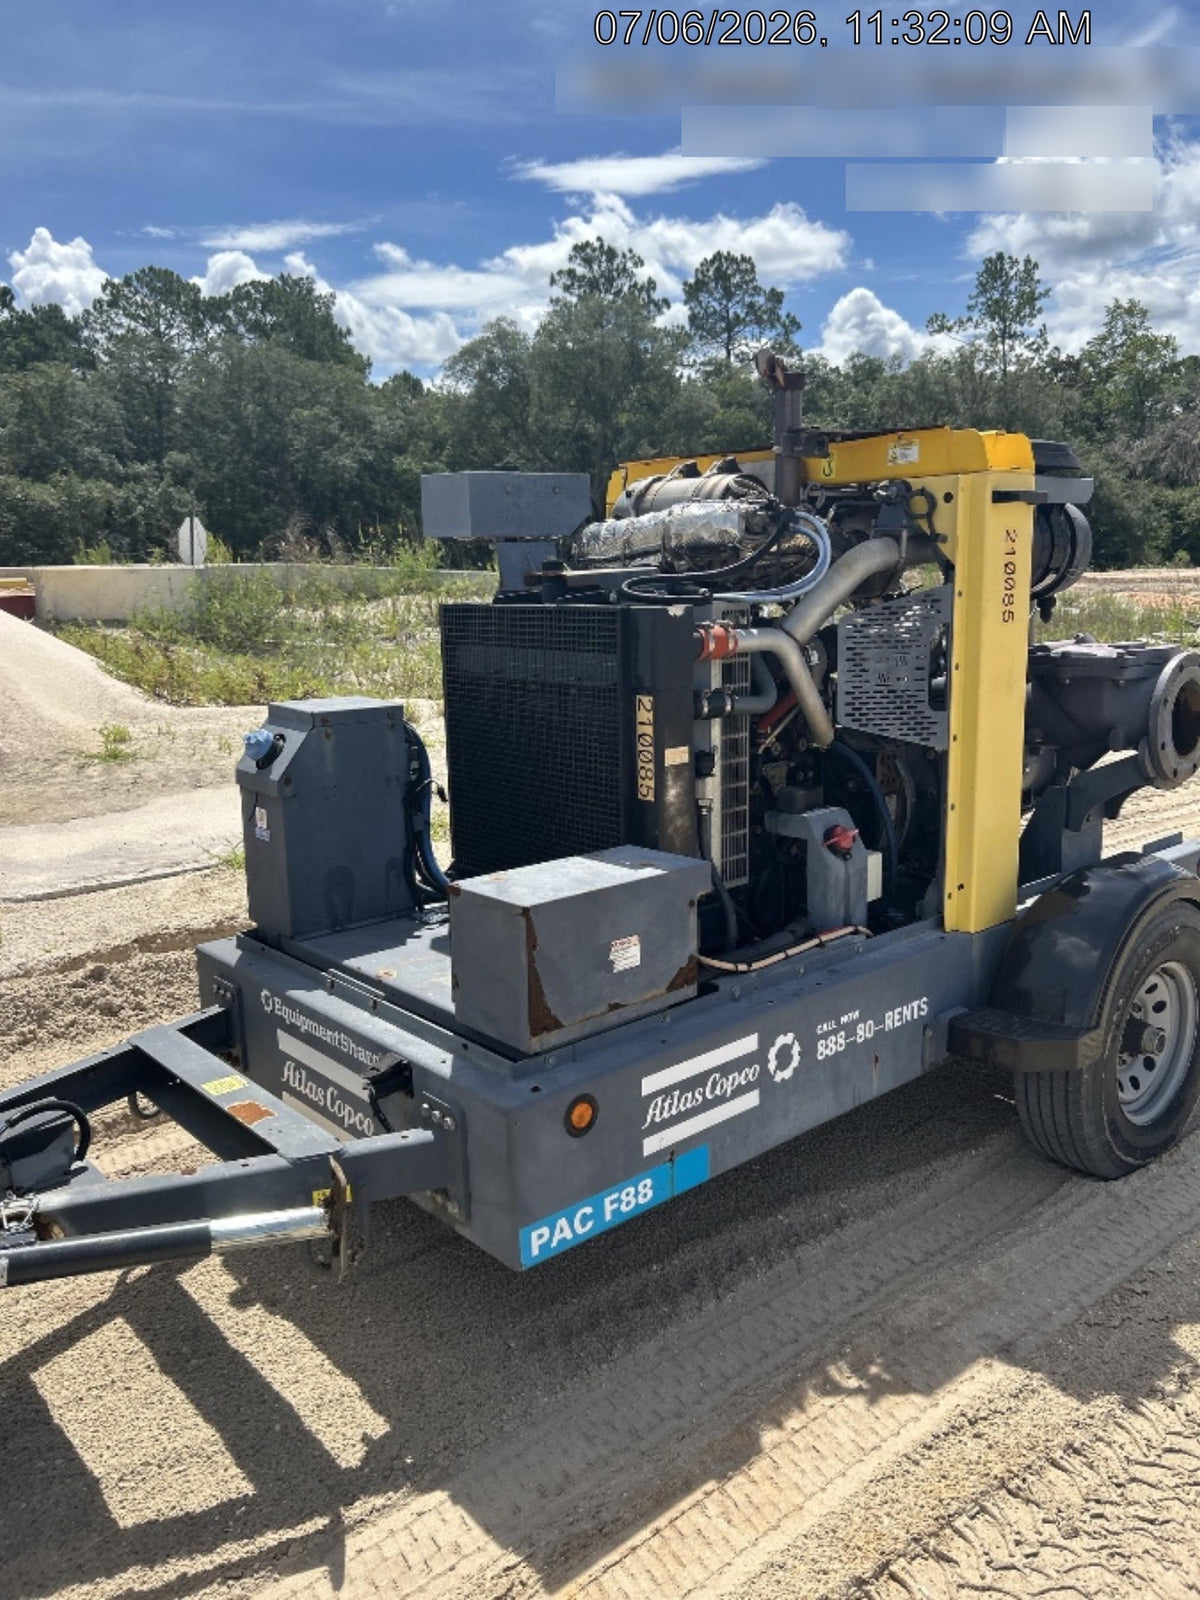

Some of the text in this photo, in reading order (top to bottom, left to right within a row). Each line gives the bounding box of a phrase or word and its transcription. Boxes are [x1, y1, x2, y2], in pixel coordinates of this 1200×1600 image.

[1002, 529, 1017, 623] 210085
[637, 697, 654, 799] 210085
[816, 1020, 837, 1034] CALL
[281, 1060, 324, 1106] Atlas
[326, 1086, 374, 1137] Copco
[641, 1064, 760, 1130] Atlas Copco
[530, 1178, 654, 1258] PAC F88
